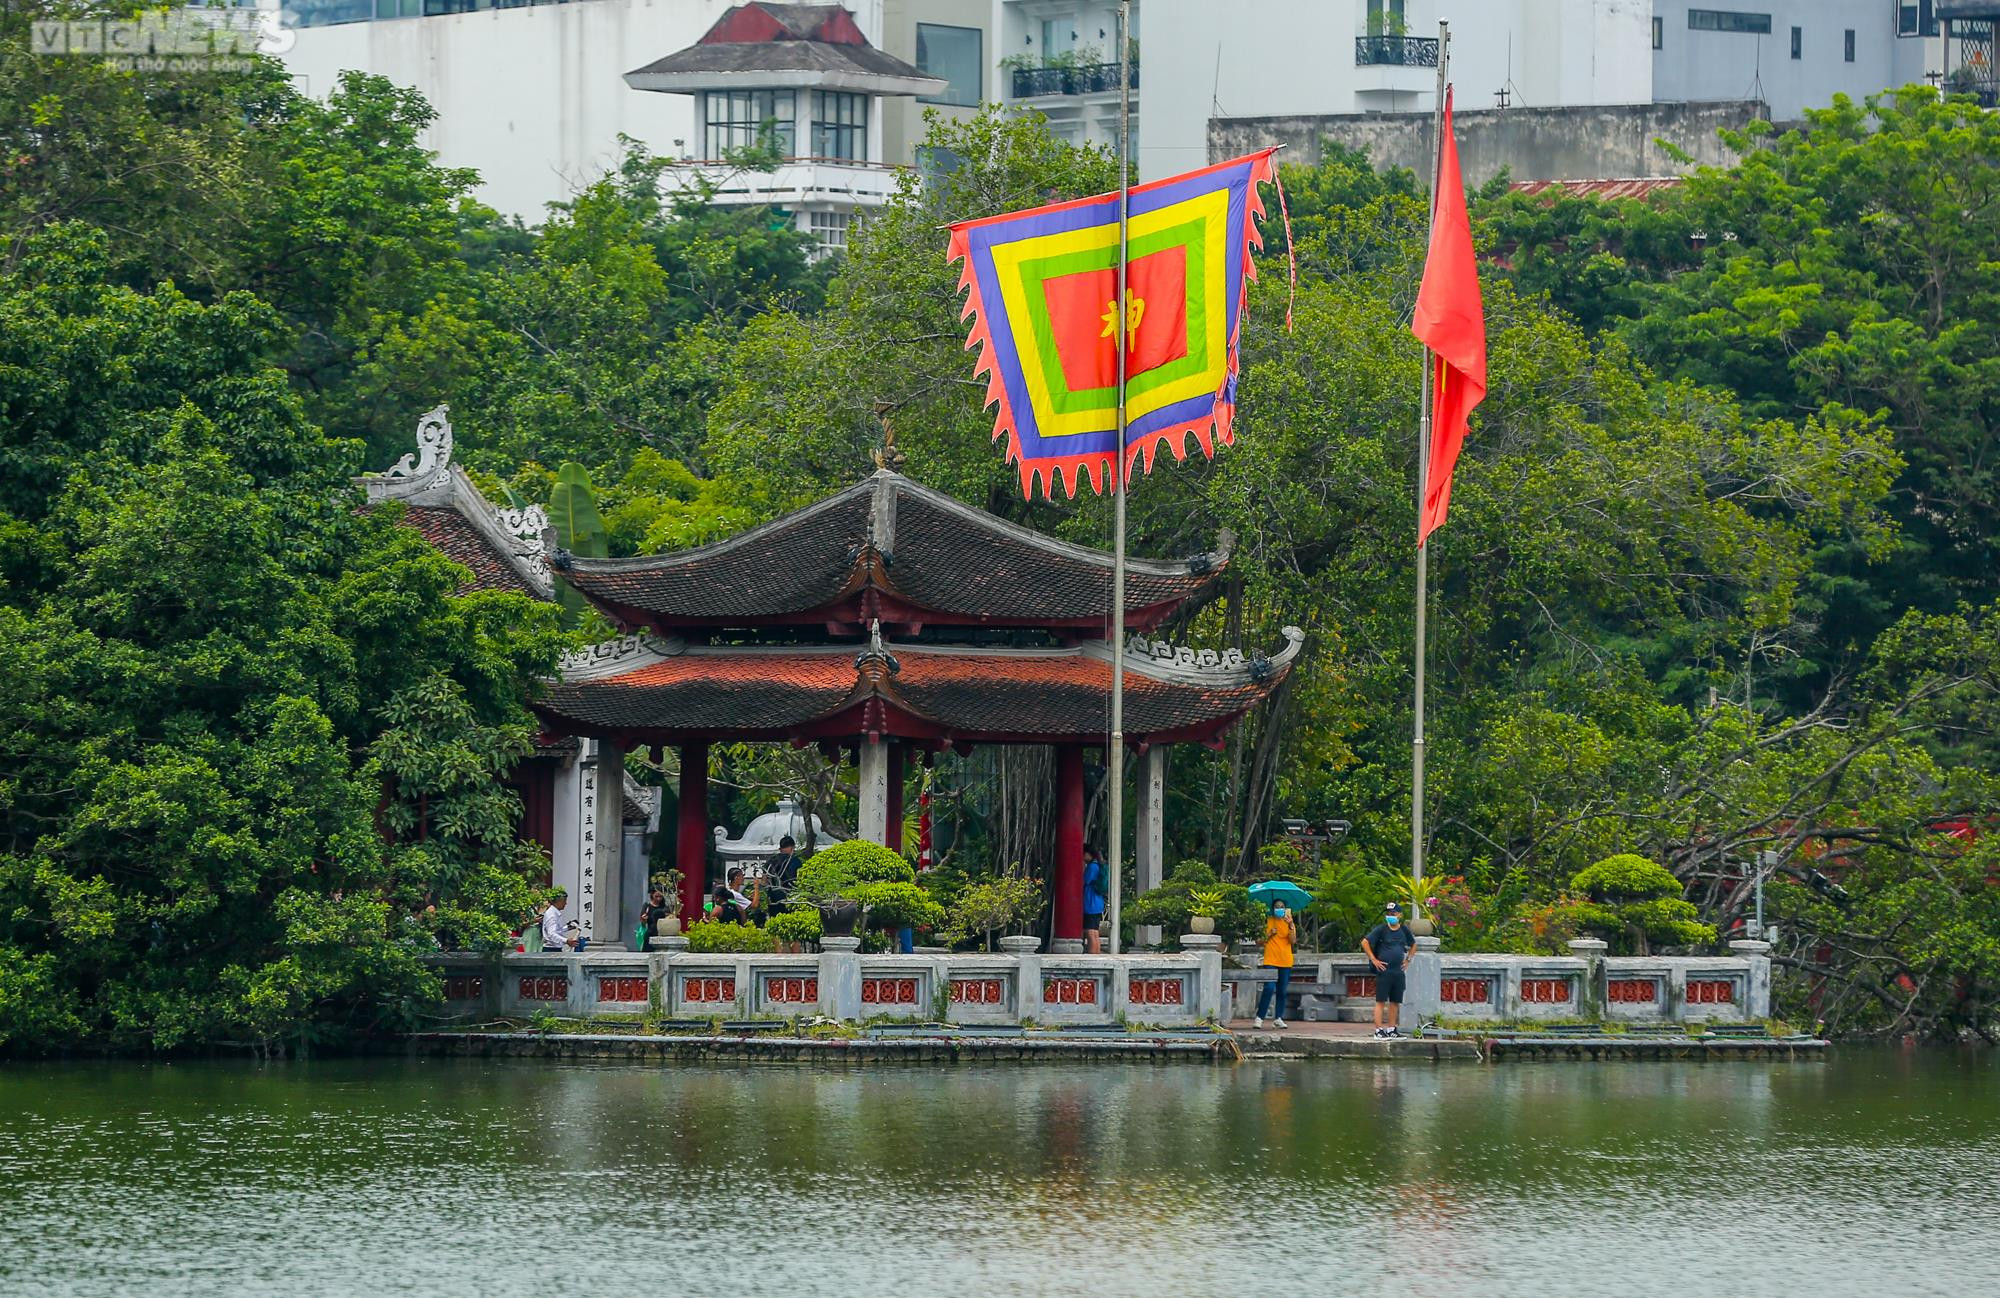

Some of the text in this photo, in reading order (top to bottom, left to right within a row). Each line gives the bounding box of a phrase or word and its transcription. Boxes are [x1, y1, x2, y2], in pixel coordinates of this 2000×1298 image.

[583, 777, 594, 942] 道有主張斗北文明之
